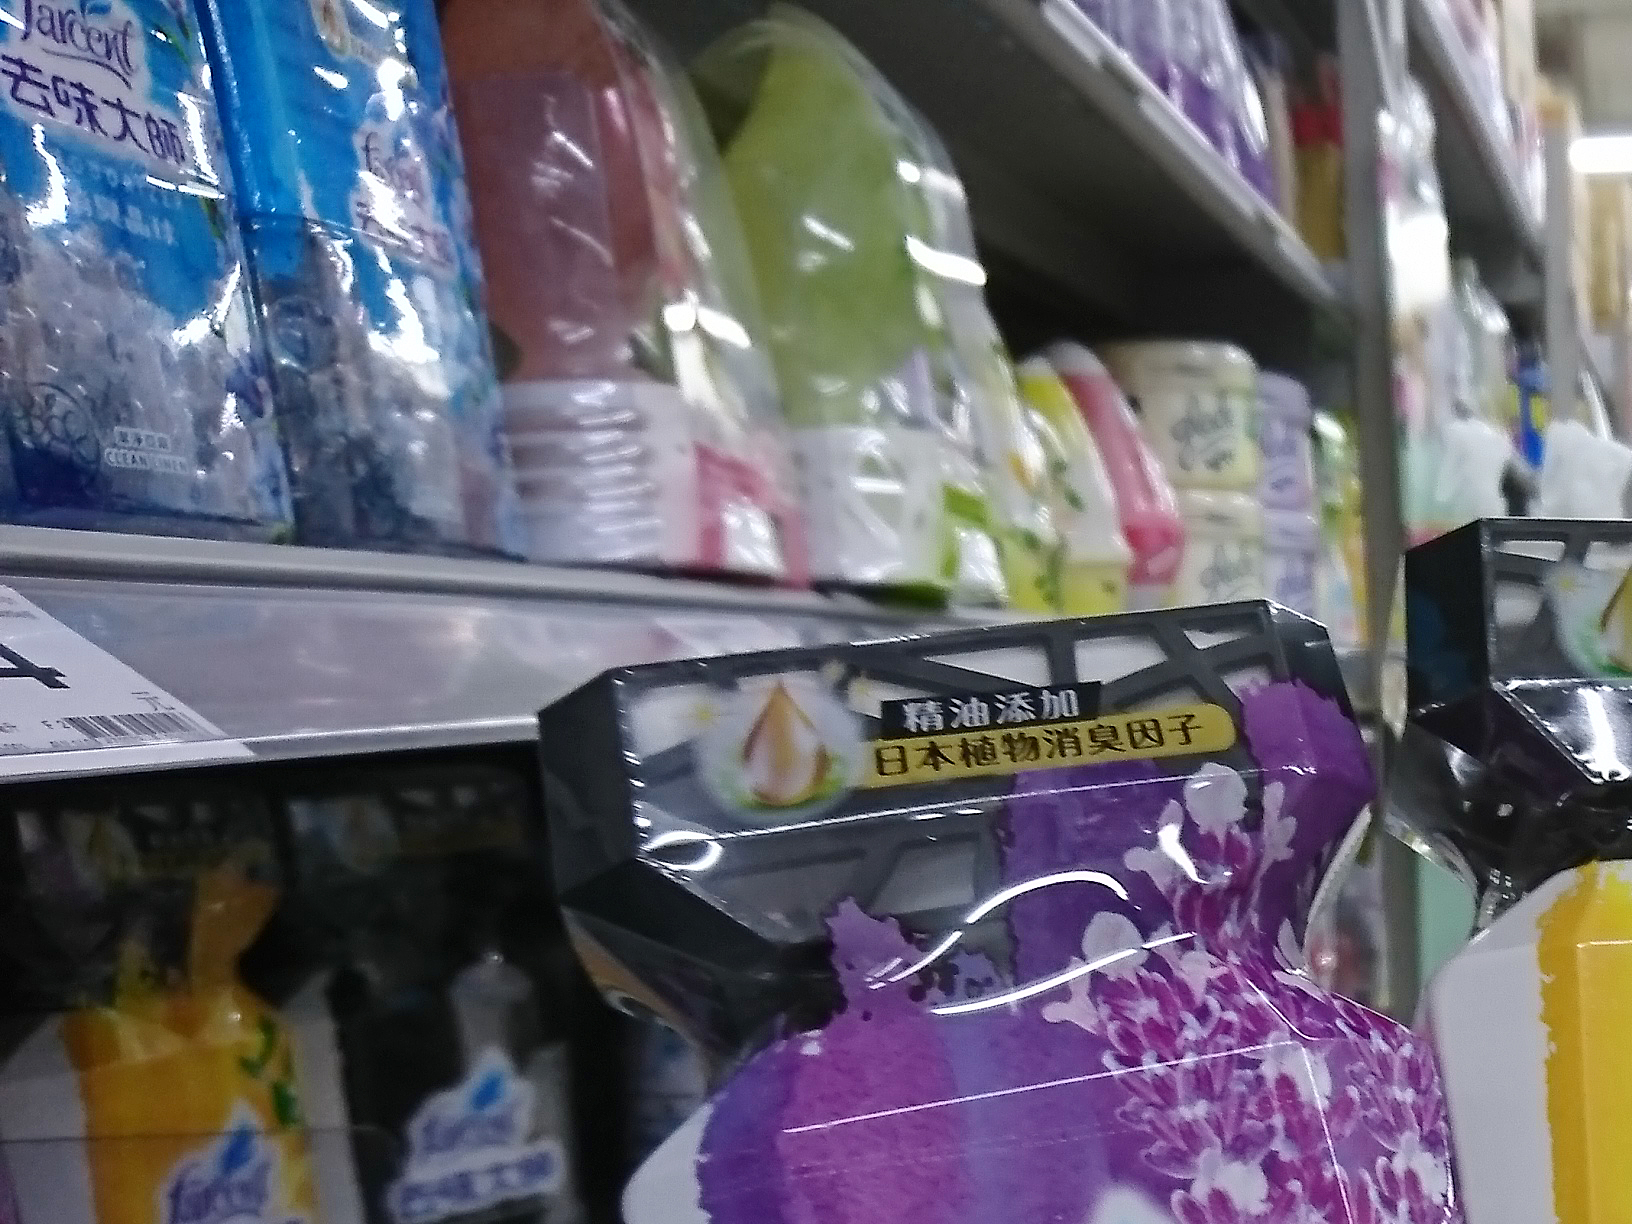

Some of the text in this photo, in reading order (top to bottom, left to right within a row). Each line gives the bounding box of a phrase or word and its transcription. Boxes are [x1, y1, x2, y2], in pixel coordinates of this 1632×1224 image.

[1, 53, 187, 166] 去味大師
[902, 687, 1081, 734] 精油添加
[874, 712, 1206, 779] 日本植物消臭因子
